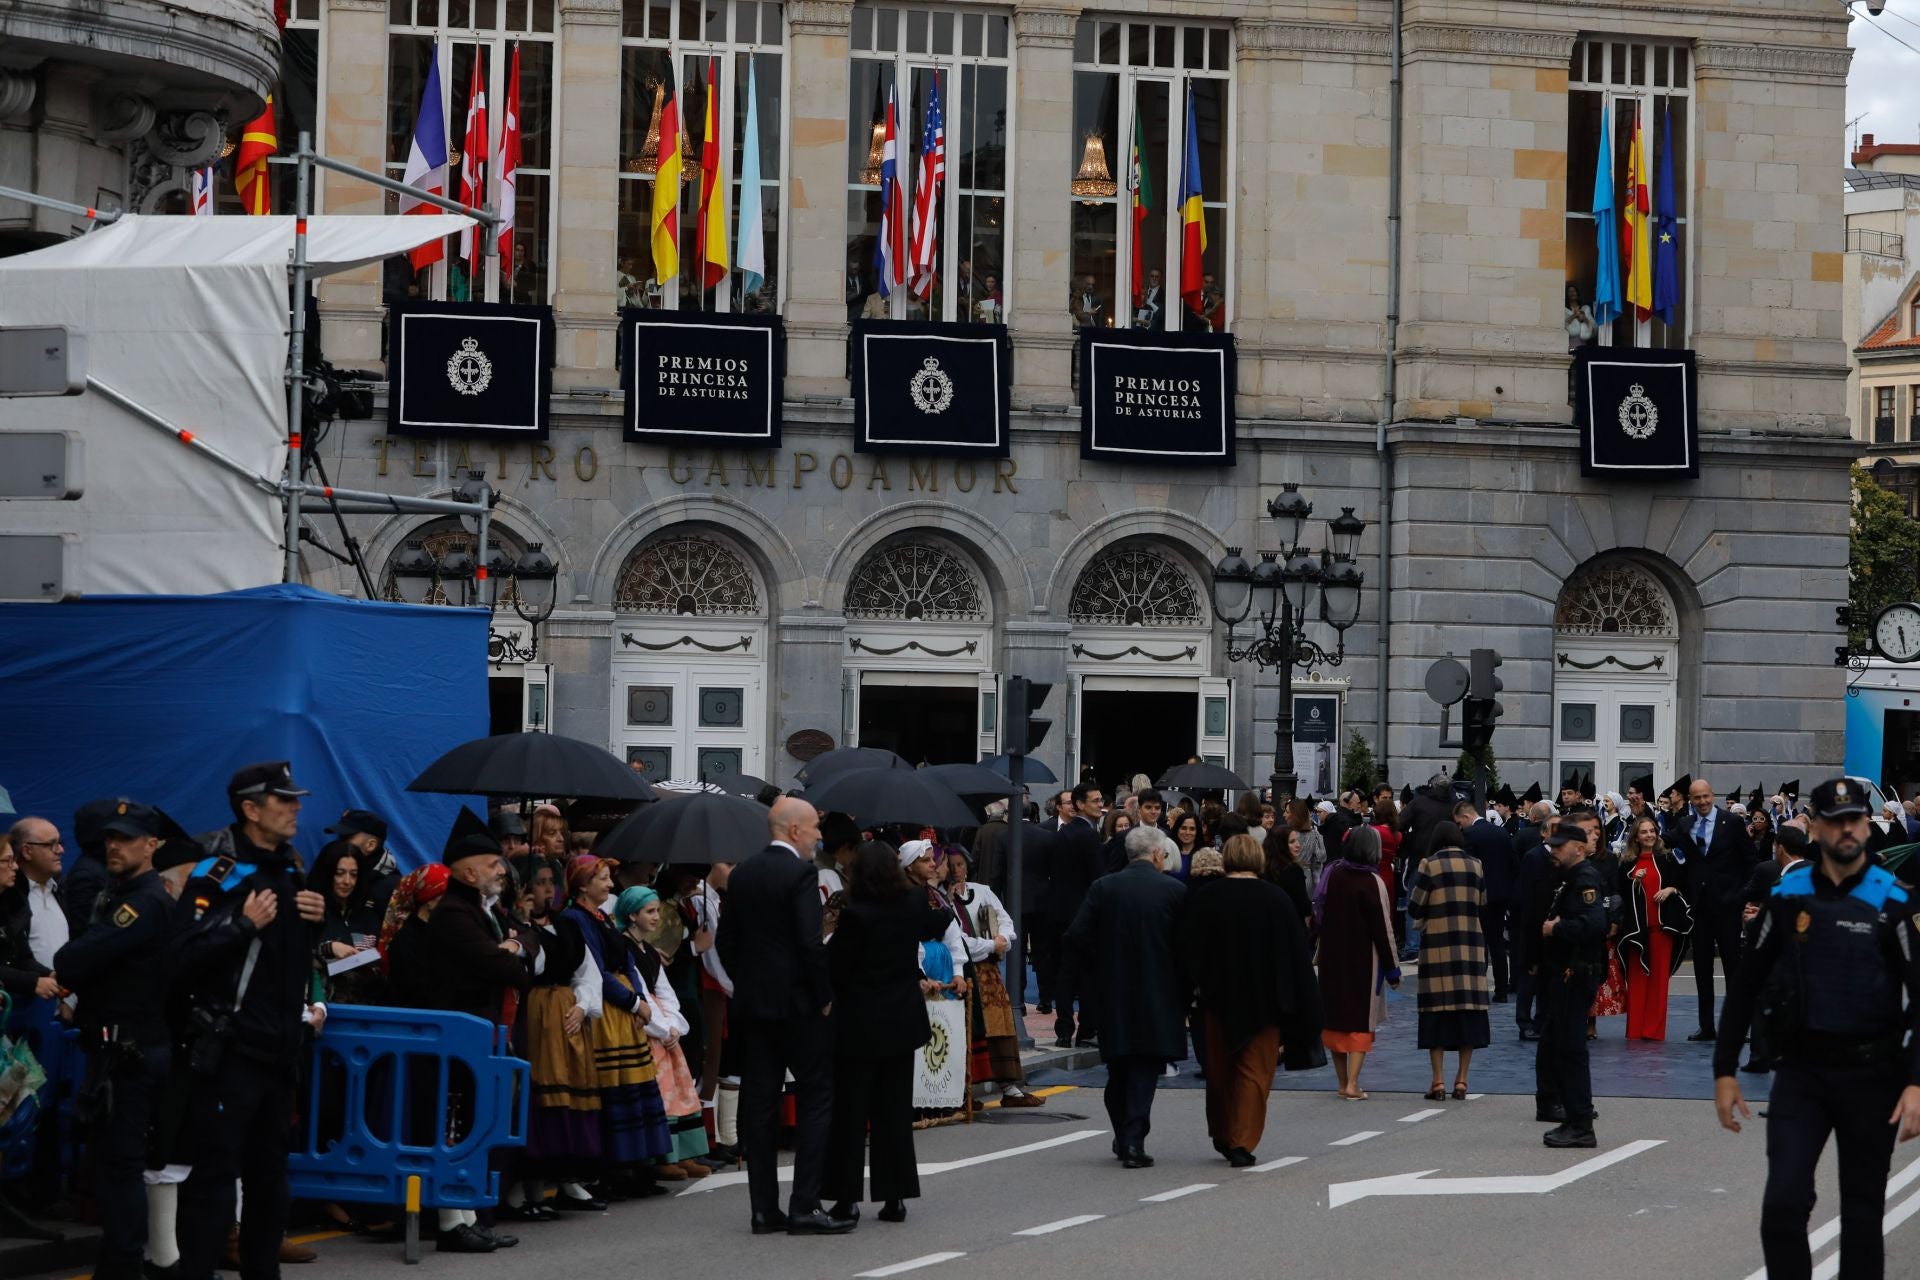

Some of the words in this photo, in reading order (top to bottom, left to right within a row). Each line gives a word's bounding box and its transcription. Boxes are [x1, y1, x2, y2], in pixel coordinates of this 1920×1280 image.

[658, 355, 748, 372] PREMIOS
[658, 371, 748, 387] PRINCESA
[1114, 375, 1201, 392] PREMIOS
[658, 386, 676, 396] DE
[682, 388, 748, 399] ASTURIAS
[1114, 391, 1201, 407] PRINCESA
[1115, 406, 1132, 416] DE
[1138, 408, 1202, 419] ASTURIAS
[371, 439, 599, 482] TEATRO
[667, 451, 1018, 494] CAMPOAMOR
